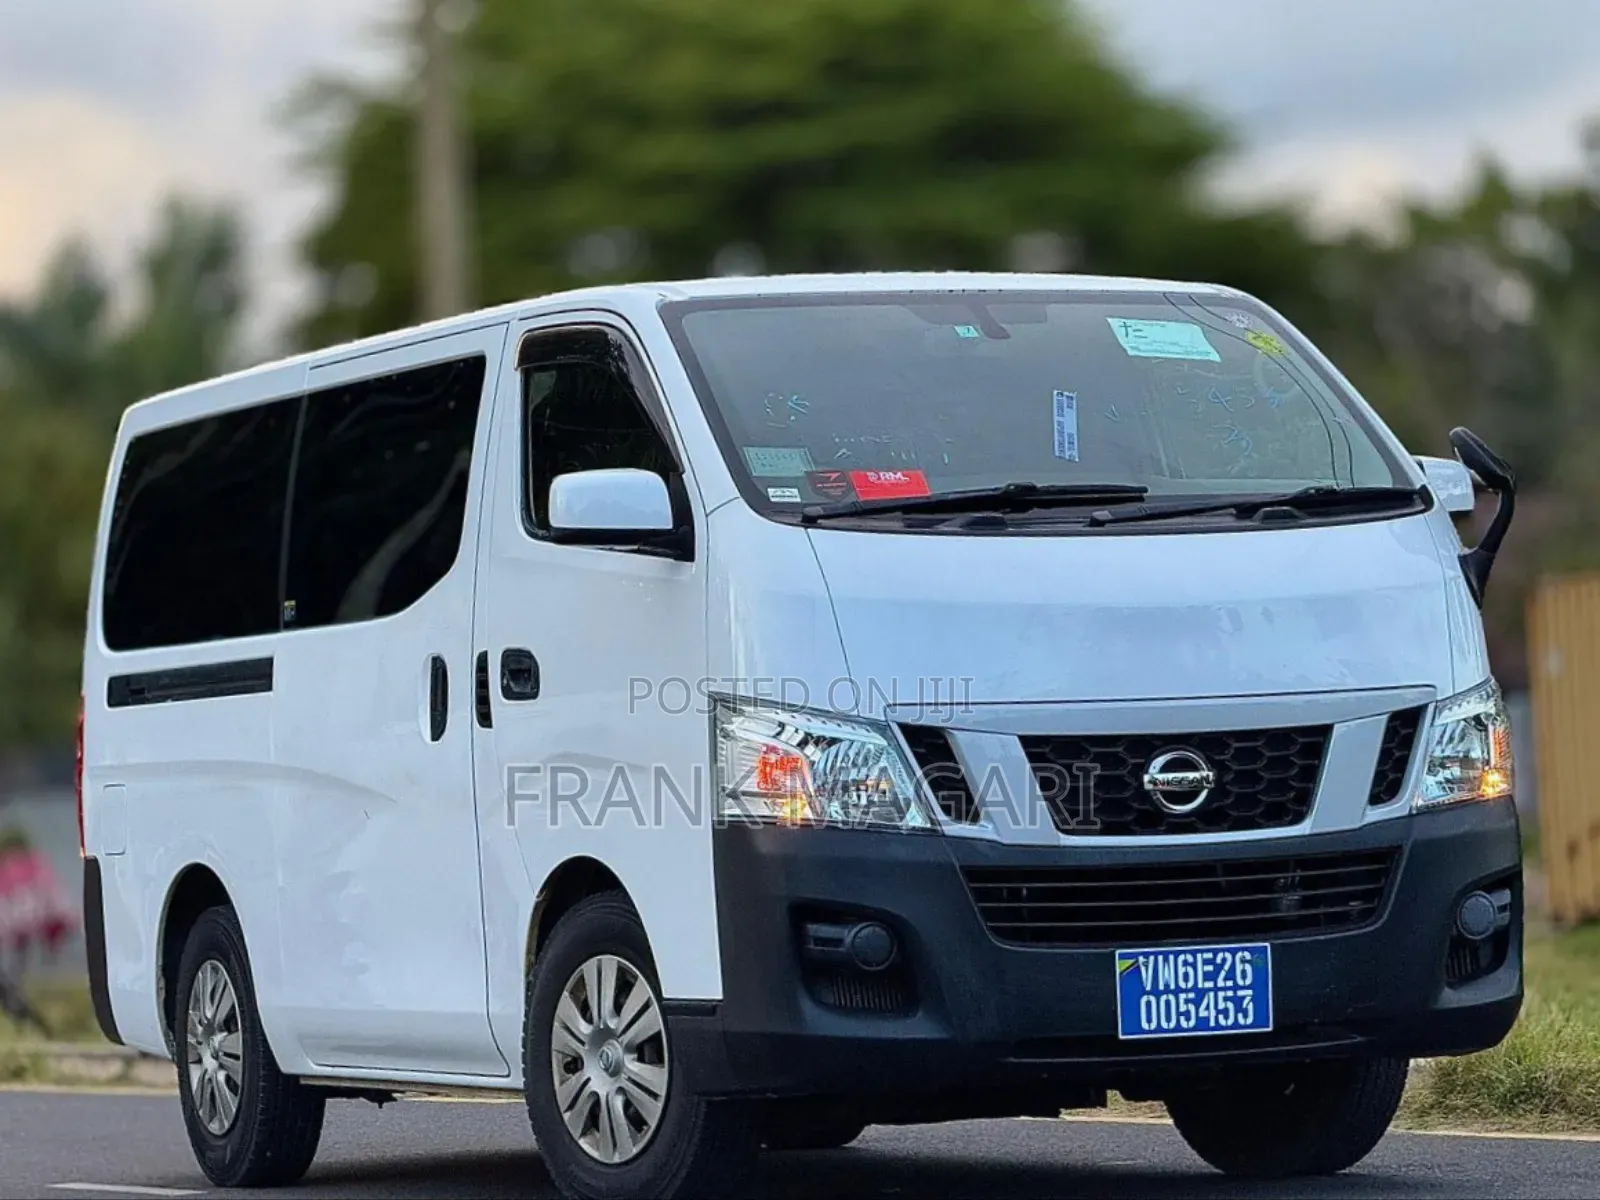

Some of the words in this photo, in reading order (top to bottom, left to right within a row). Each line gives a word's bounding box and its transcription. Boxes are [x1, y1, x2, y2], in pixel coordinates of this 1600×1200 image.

[1152, 773, 1212, 788] NISSAN
[1138, 951, 1253, 990] VW6E26
[1139, 989, 1254, 1031] 005453
